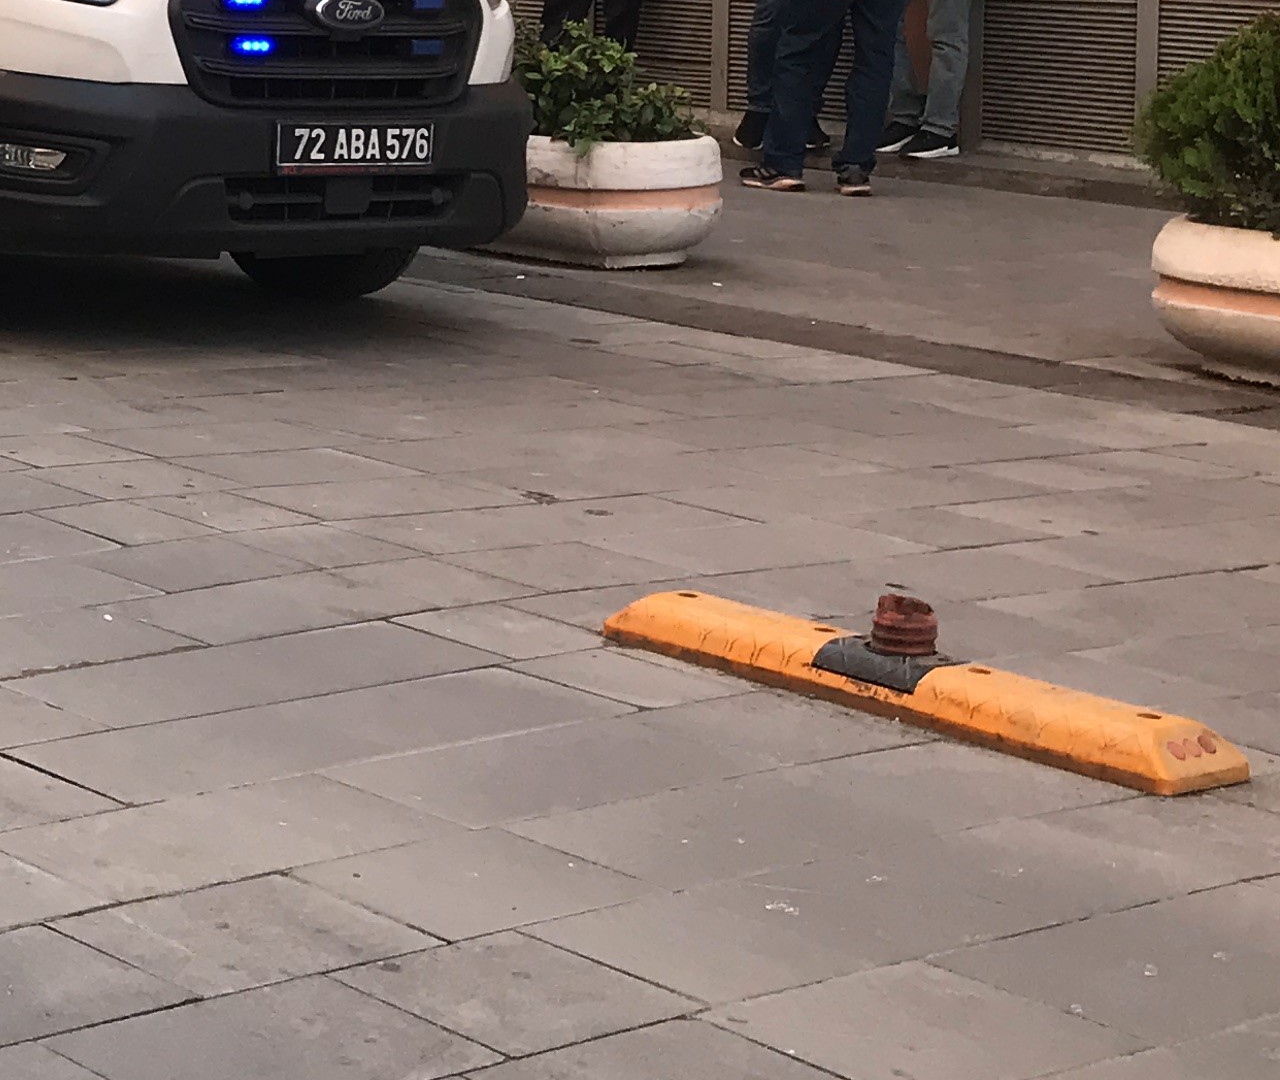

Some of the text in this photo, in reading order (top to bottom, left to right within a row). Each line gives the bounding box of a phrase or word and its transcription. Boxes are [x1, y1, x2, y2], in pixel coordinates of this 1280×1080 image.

[335, 0, 373, 20] Ford
[294, 127, 429, 160] 72 ABA 576
